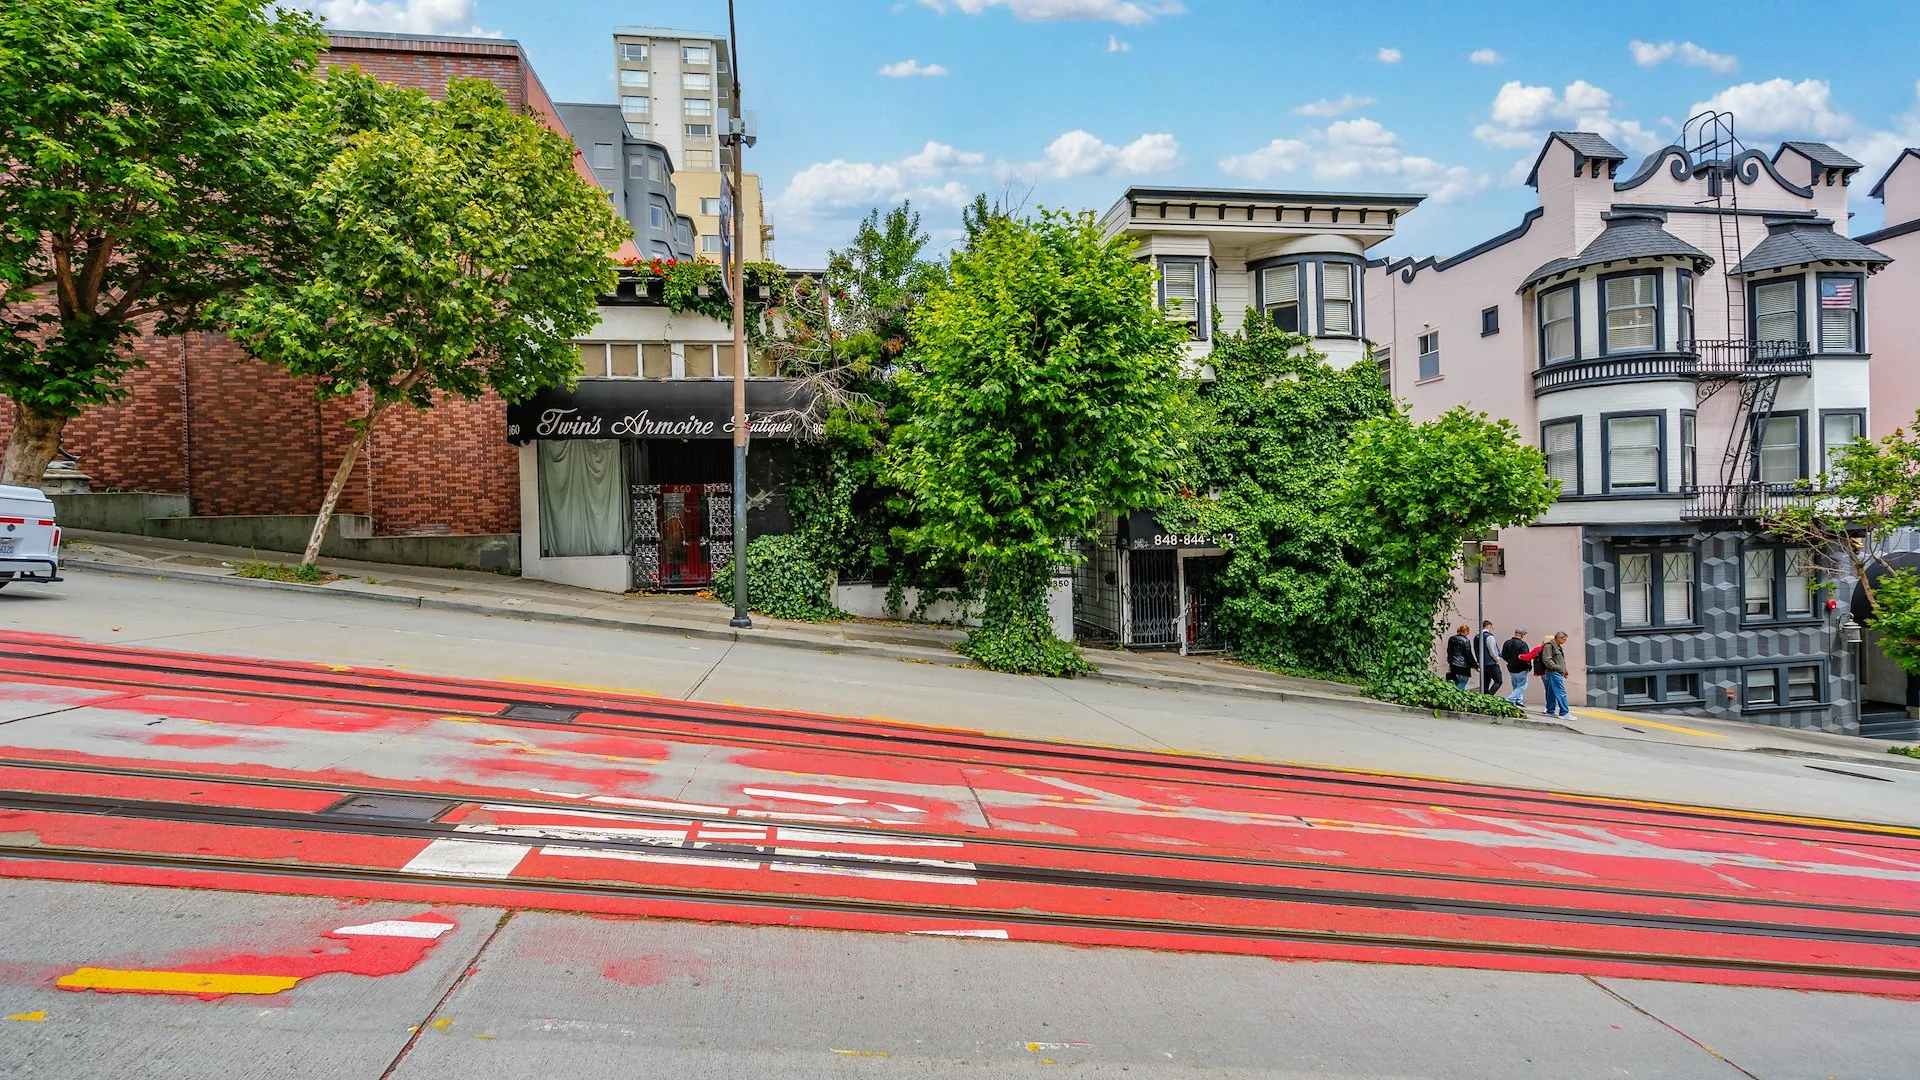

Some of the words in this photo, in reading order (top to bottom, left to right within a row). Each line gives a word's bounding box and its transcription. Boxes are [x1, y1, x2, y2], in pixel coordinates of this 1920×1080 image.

[536, 407, 602, 436] Twin's
[611, 409, 714, 435] Armoire
[722, 413, 793, 438] Butique
[812, 422, 826, 435] 86
[673, 485, 691, 493] 860
